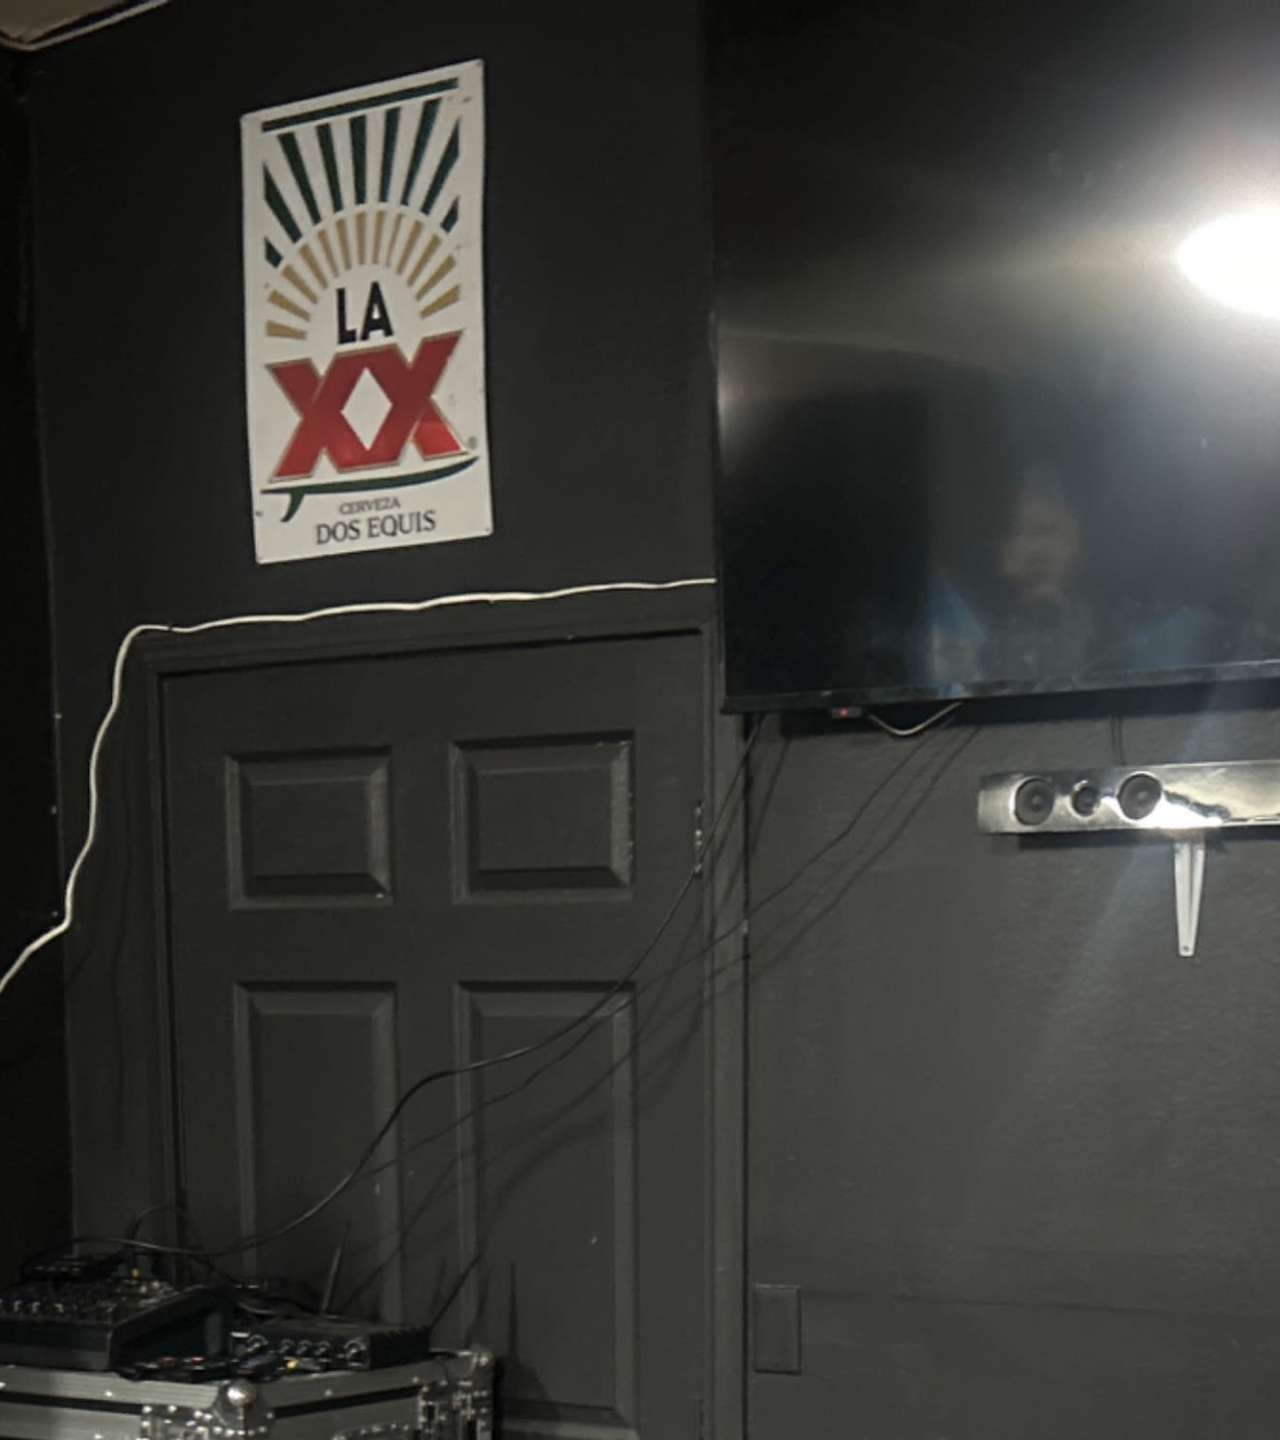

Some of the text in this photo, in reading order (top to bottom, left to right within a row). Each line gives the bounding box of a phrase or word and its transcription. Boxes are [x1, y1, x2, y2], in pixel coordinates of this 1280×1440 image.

[335, 280, 394, 345] LA
[264, 329, 469, 484] XX
[316, 510, 437, 546] DOS EQUIS
[338, 497, 402, 516] CERVEZA
